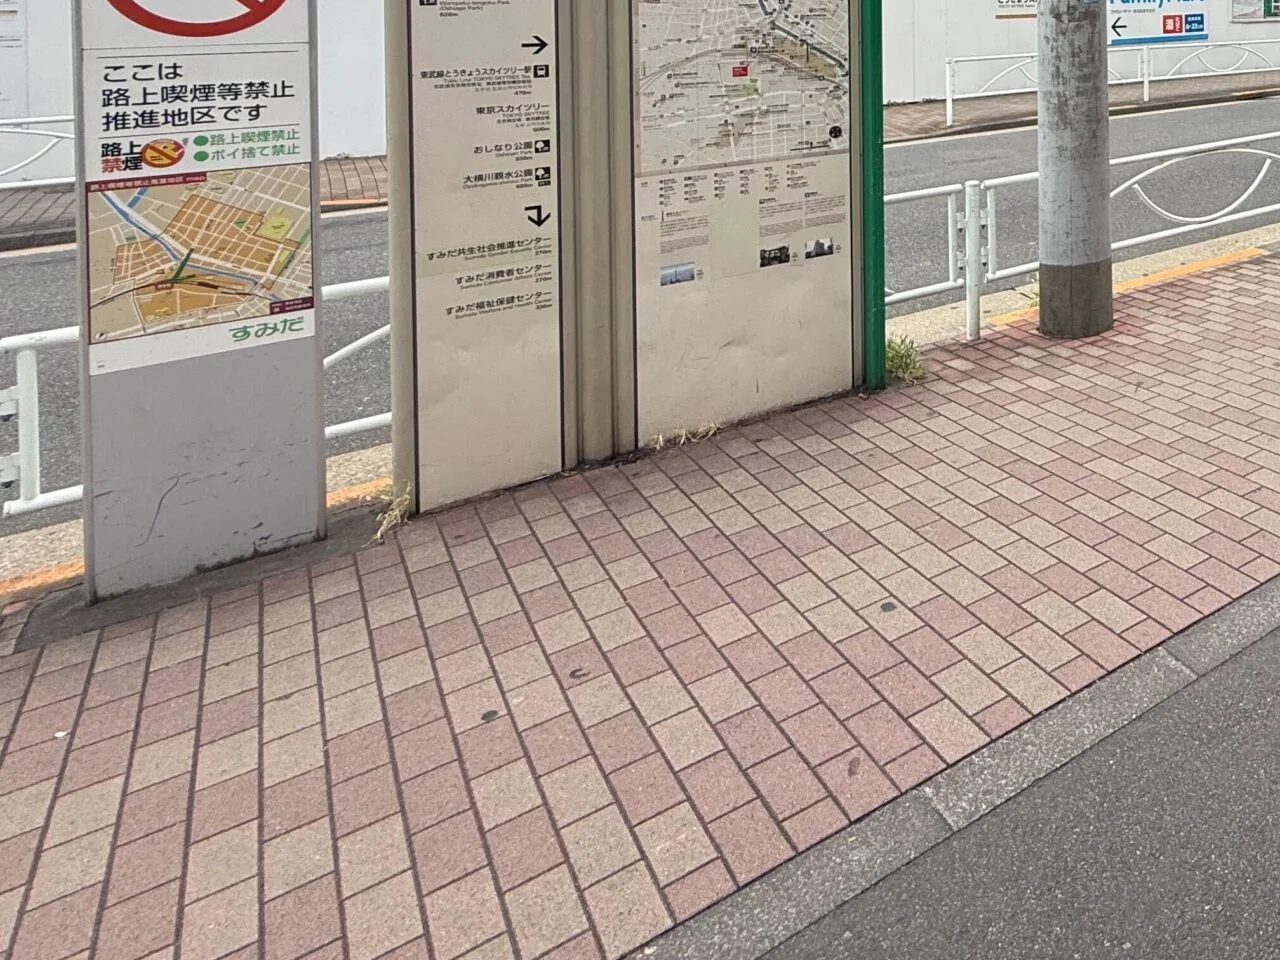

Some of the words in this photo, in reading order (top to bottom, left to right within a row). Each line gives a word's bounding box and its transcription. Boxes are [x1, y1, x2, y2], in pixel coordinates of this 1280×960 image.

[103, 62, 183, 83] ここは
[102, 80, 295, 108] 路上喫煙等禁止
[102, 104, 267, 132] 推進地区です
[476, 103, 550, 115] 東京スカイツリー
[210, 128, 299, 147] 路上喫煙禁止
[473, 141, 533, 154] おしなり公園
[101, 141, 142, 158] 路上
[211, 143, 300, 161] ポイ捨て禁止
[101, 155, 143, 173] 禁煙
[426, 237, 552, 261] すみだ共生社会推進センター
[455, 264, 552, 285] すみだ消費者センター
[445, 291, 552, 316] すみだ福祉保健センター
[229, 316, 304, 342] すみだ
